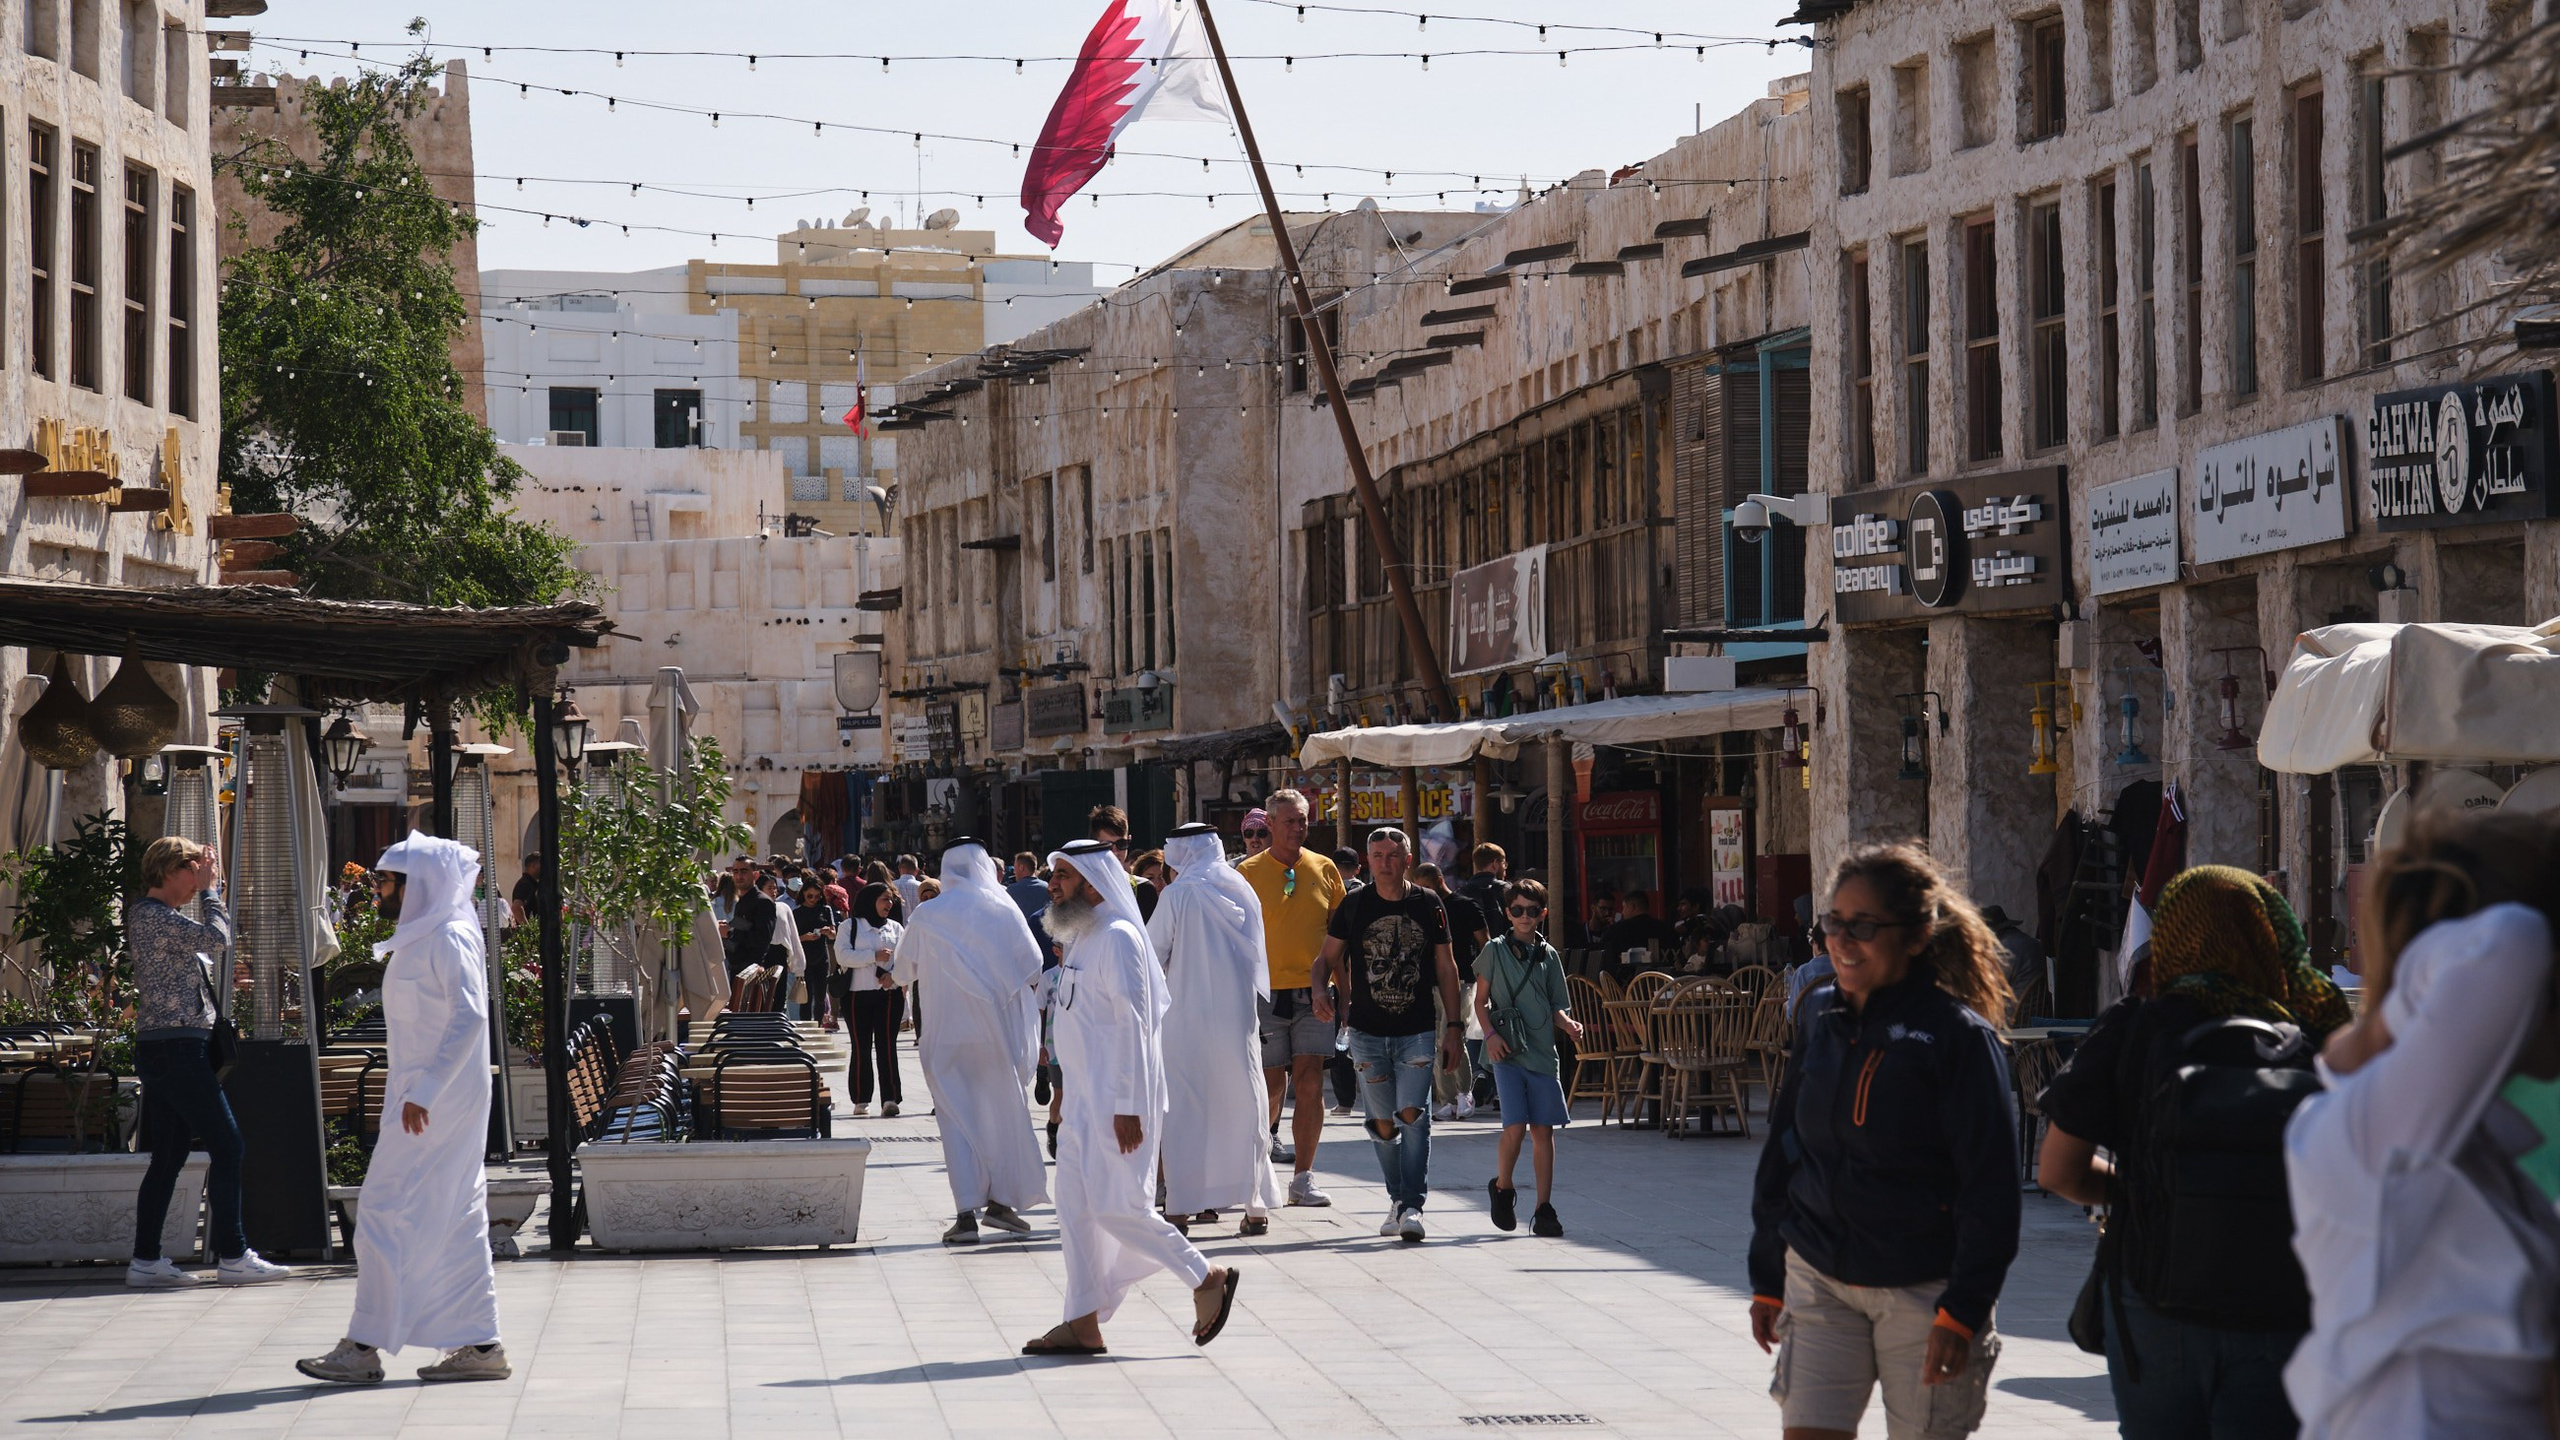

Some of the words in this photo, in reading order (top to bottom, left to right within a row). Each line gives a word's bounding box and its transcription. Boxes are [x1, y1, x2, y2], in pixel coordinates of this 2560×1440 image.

[2369, 401, 2434, 458] GAHWA
[2475, 384, 2524, 445] قهوة
[2200, 453, 2256, 524] للتراث
[2267, 430, 2335, 512] شراعوه
[2370, 464, 2435, 519] SULTAN
[2473, 445, 2527, 511] سلطان
[1833, 513, 1892, 558] coffee
[1963, 495, 2034, 539] كوفي
[1835, 564, 1891, 597] beanery
[1318, 791, 1385, 820] FESH
[1391, 789, 1454, 818] JICE
